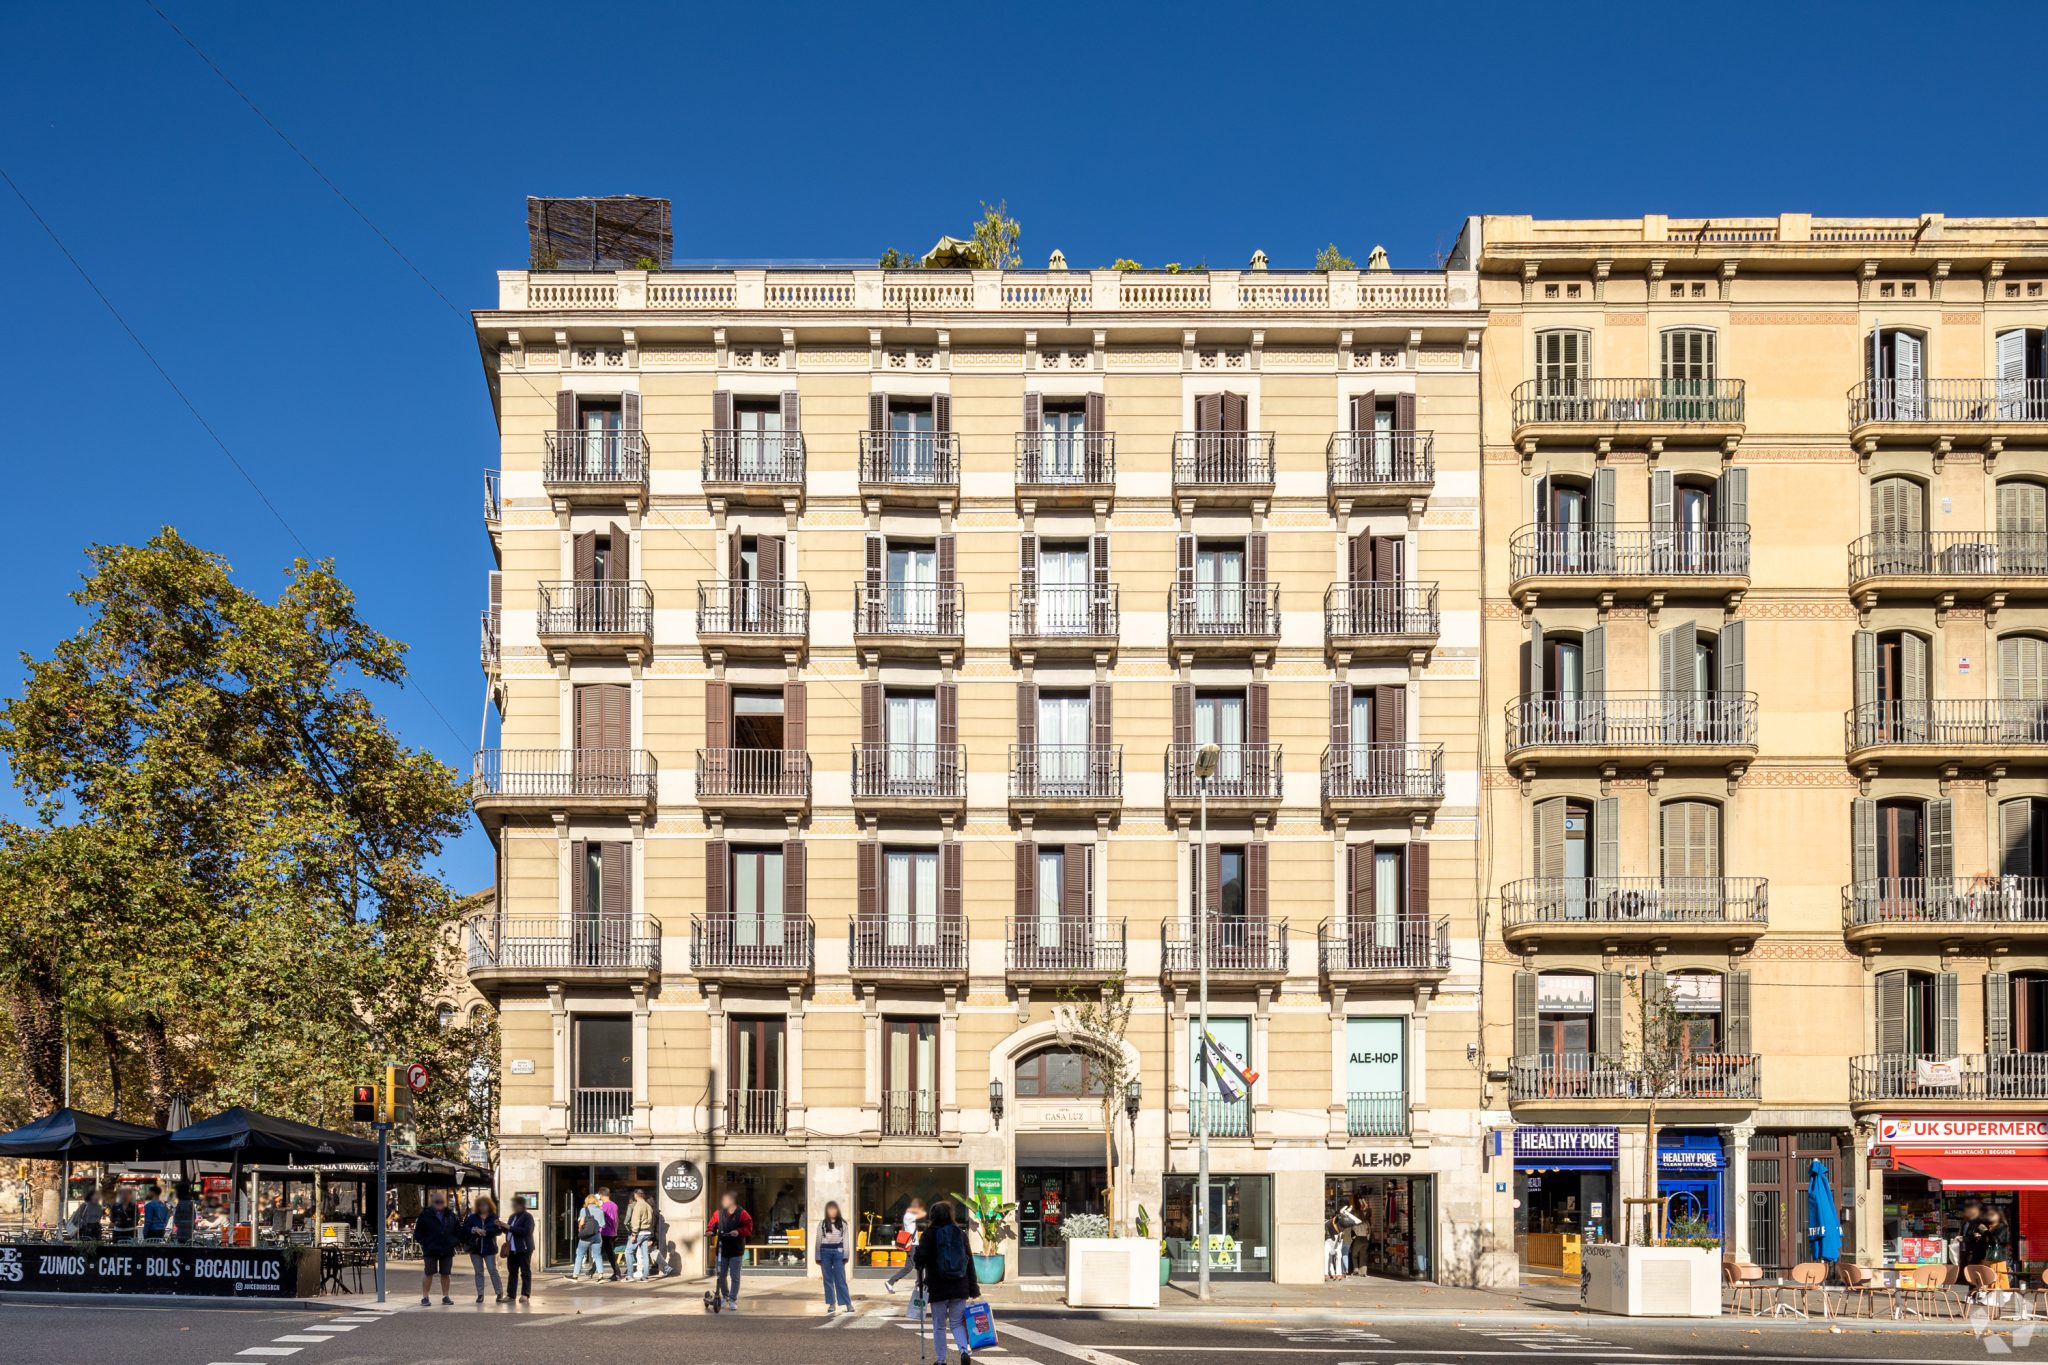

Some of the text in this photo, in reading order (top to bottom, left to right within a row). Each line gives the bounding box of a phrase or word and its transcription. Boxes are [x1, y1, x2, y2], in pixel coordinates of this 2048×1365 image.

[1349, 1052, 1399, 1064] ALE-HOP
[1045, 1112, 1084, 1121] CASA LUZ
[1914, 1122, 1939, 1136] UK
[1521, 1132, 1615, 1149] HEALTHY POKE
[1351, 1152, 1412, 1168] ALE-HOP
[1662, 1152, 1717, 1163] HEALTHY POKE
[1791, 1150, 1797, 1159] 3
[38, 1255, 280, 1280] ZUMOS CAFE BOLS BOCADILLOS
